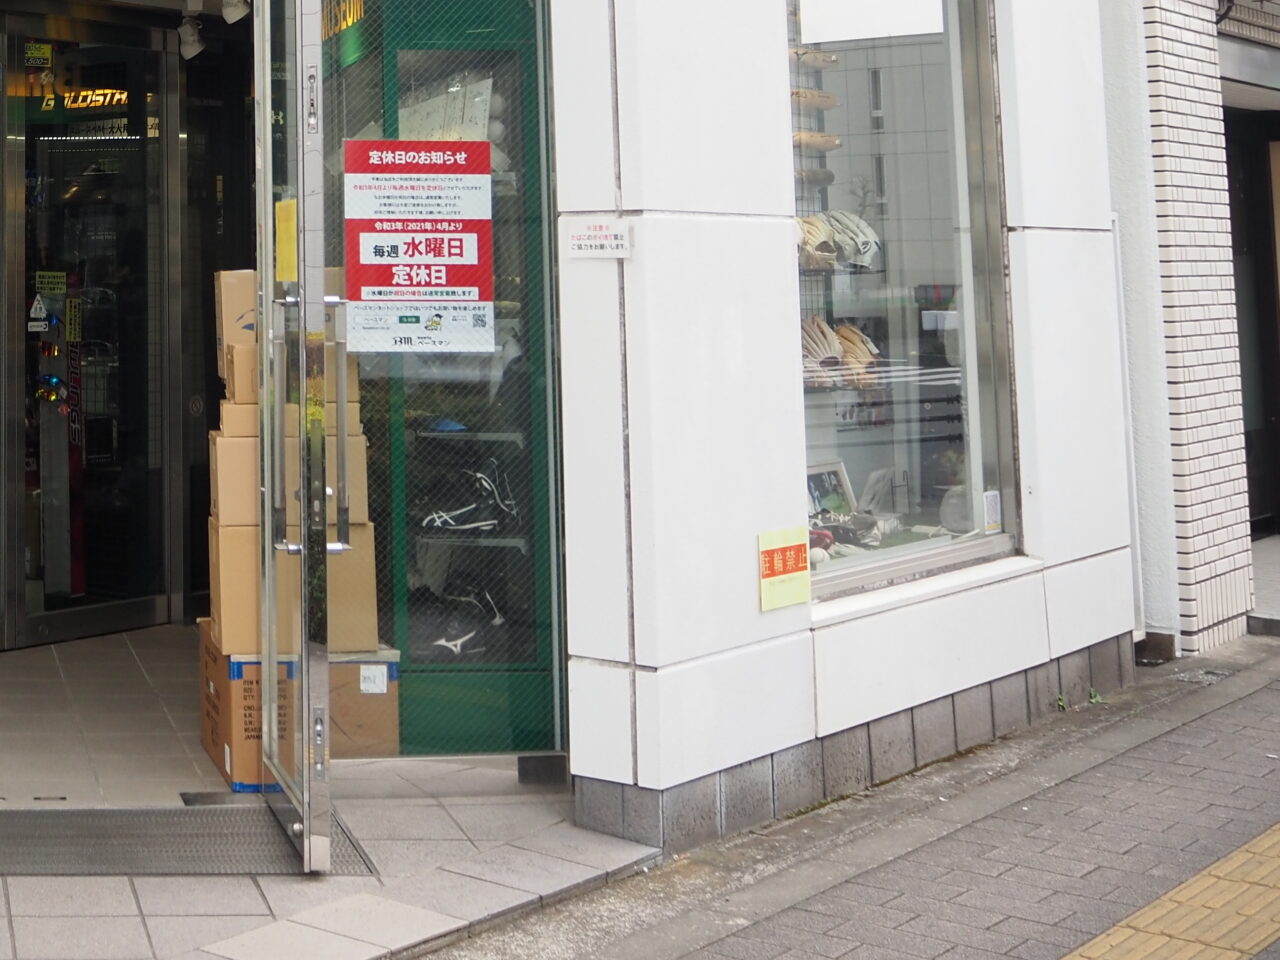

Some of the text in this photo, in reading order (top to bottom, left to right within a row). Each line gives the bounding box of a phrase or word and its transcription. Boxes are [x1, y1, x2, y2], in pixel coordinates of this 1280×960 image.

[369, 150, 468, 165] 定休日のお知らせ
[372, 236, 464, 259] 毎週 水曜日
[391, 265, 447, 285] 定休日
[760, 545, 808, 576] 駐輪禁止
